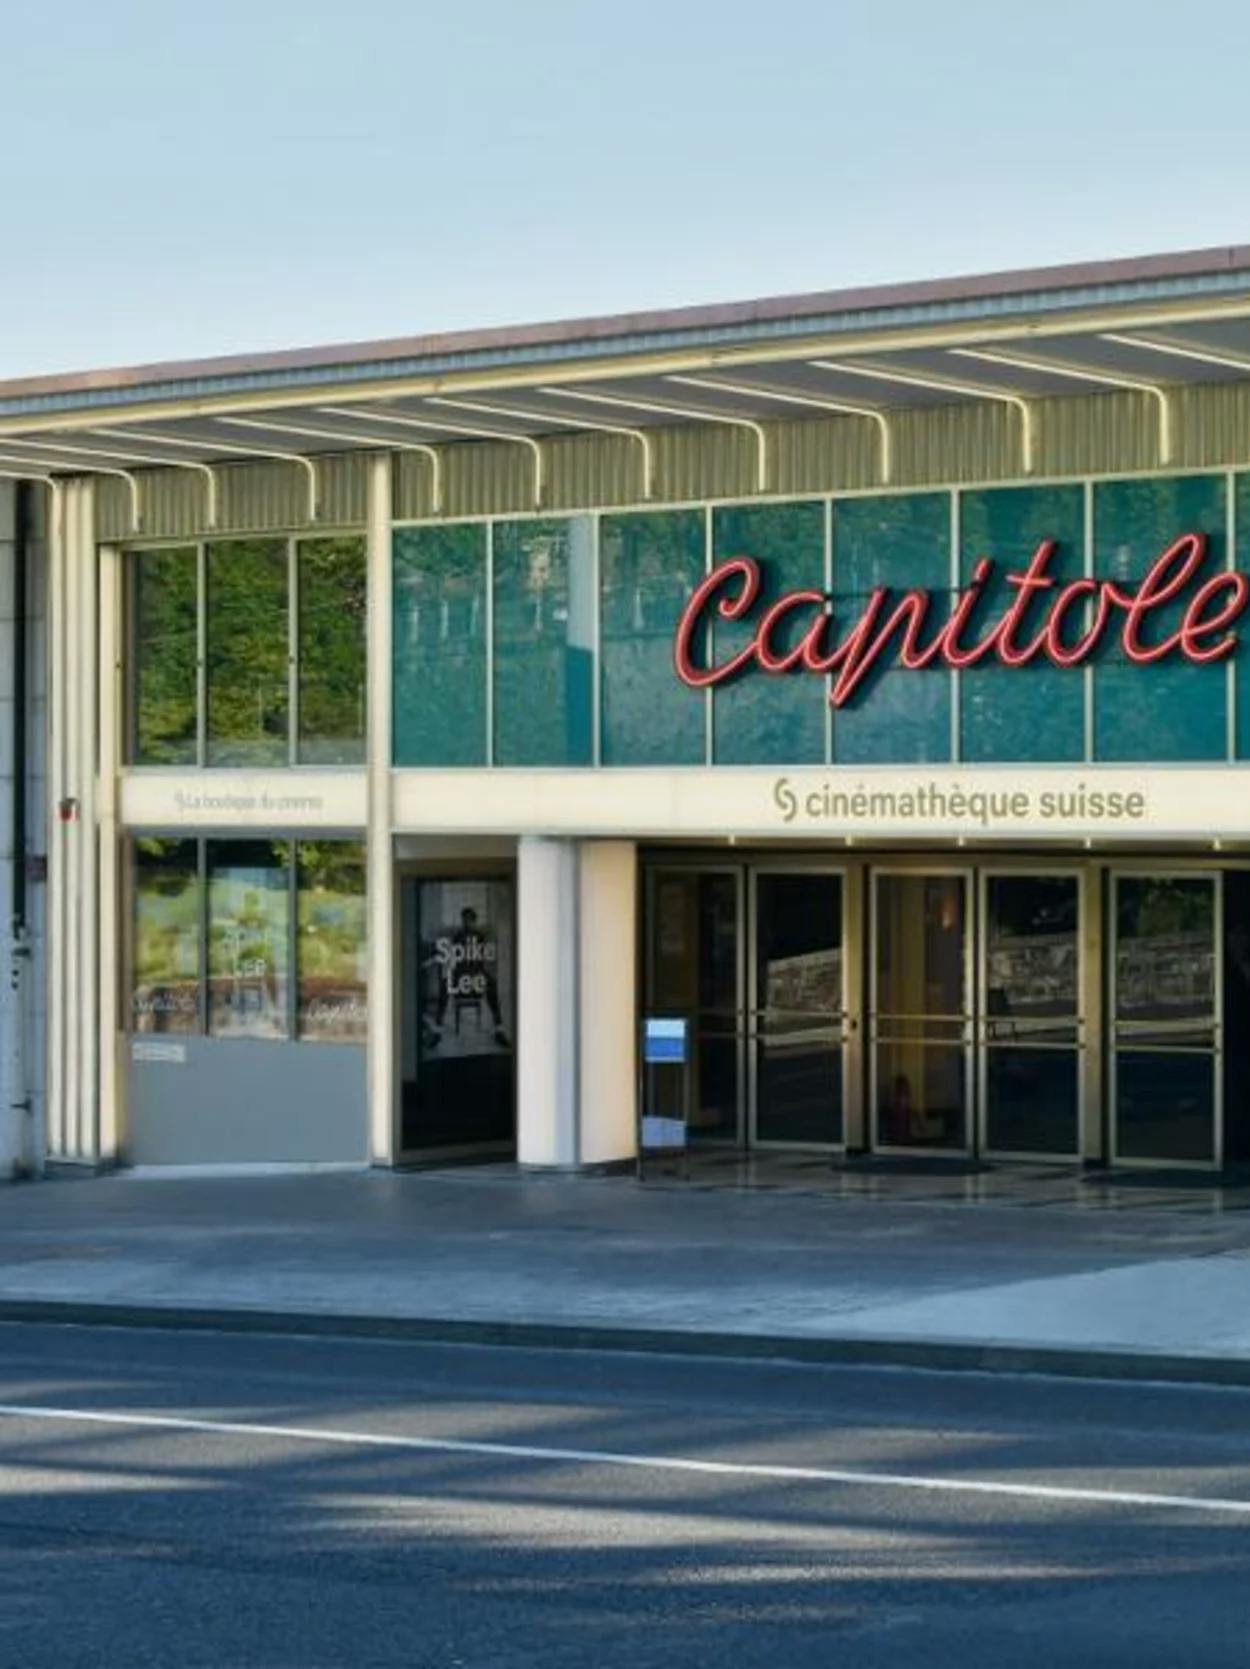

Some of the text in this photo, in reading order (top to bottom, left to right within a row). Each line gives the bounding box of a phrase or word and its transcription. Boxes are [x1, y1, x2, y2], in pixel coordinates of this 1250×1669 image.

[674, 533, 1250, 709] Capitole
[805, 783, 1145, 826] cinémathèque suisse
[435, 936, 496, 968] Spike
[447, 969, 487, 994] Lee
